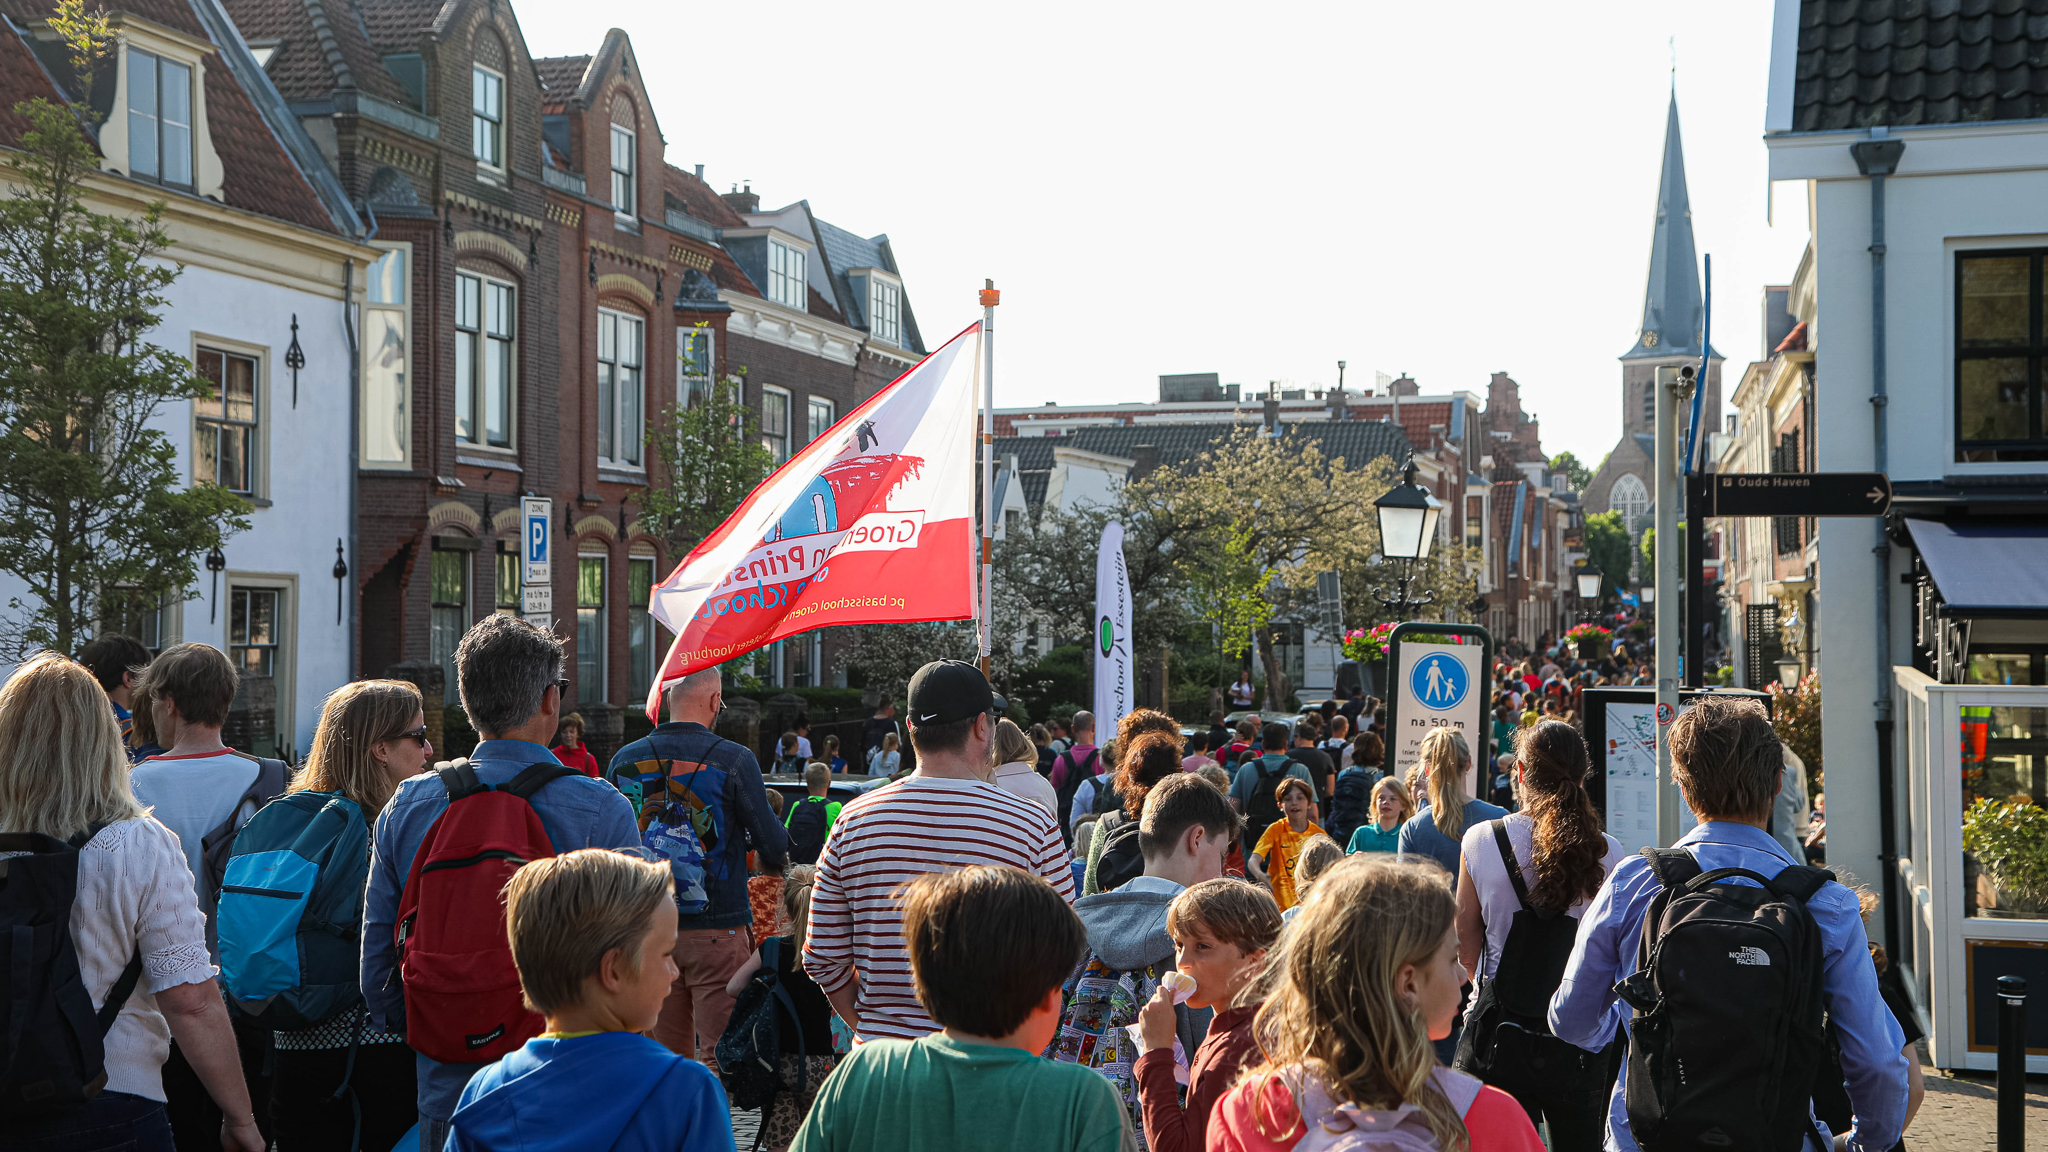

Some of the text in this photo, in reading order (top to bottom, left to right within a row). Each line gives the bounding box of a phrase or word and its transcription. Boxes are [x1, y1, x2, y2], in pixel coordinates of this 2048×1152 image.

[1738, 477, 1810, 487] Oude Haven
[531, 504, 544, 513] ZONE
[532, 522, 544, 558] P
[1114, 550, 1125, 628] Essesteijn
[1411, 717, 1465, 729] na 50 m
[1740, 945, 1757, 954] THE
[1728, 951, 1756, 960] NORTH
[1736, 958, 1756, 966] FACE
[1677, 1058, 1687, 1085] VAULT
